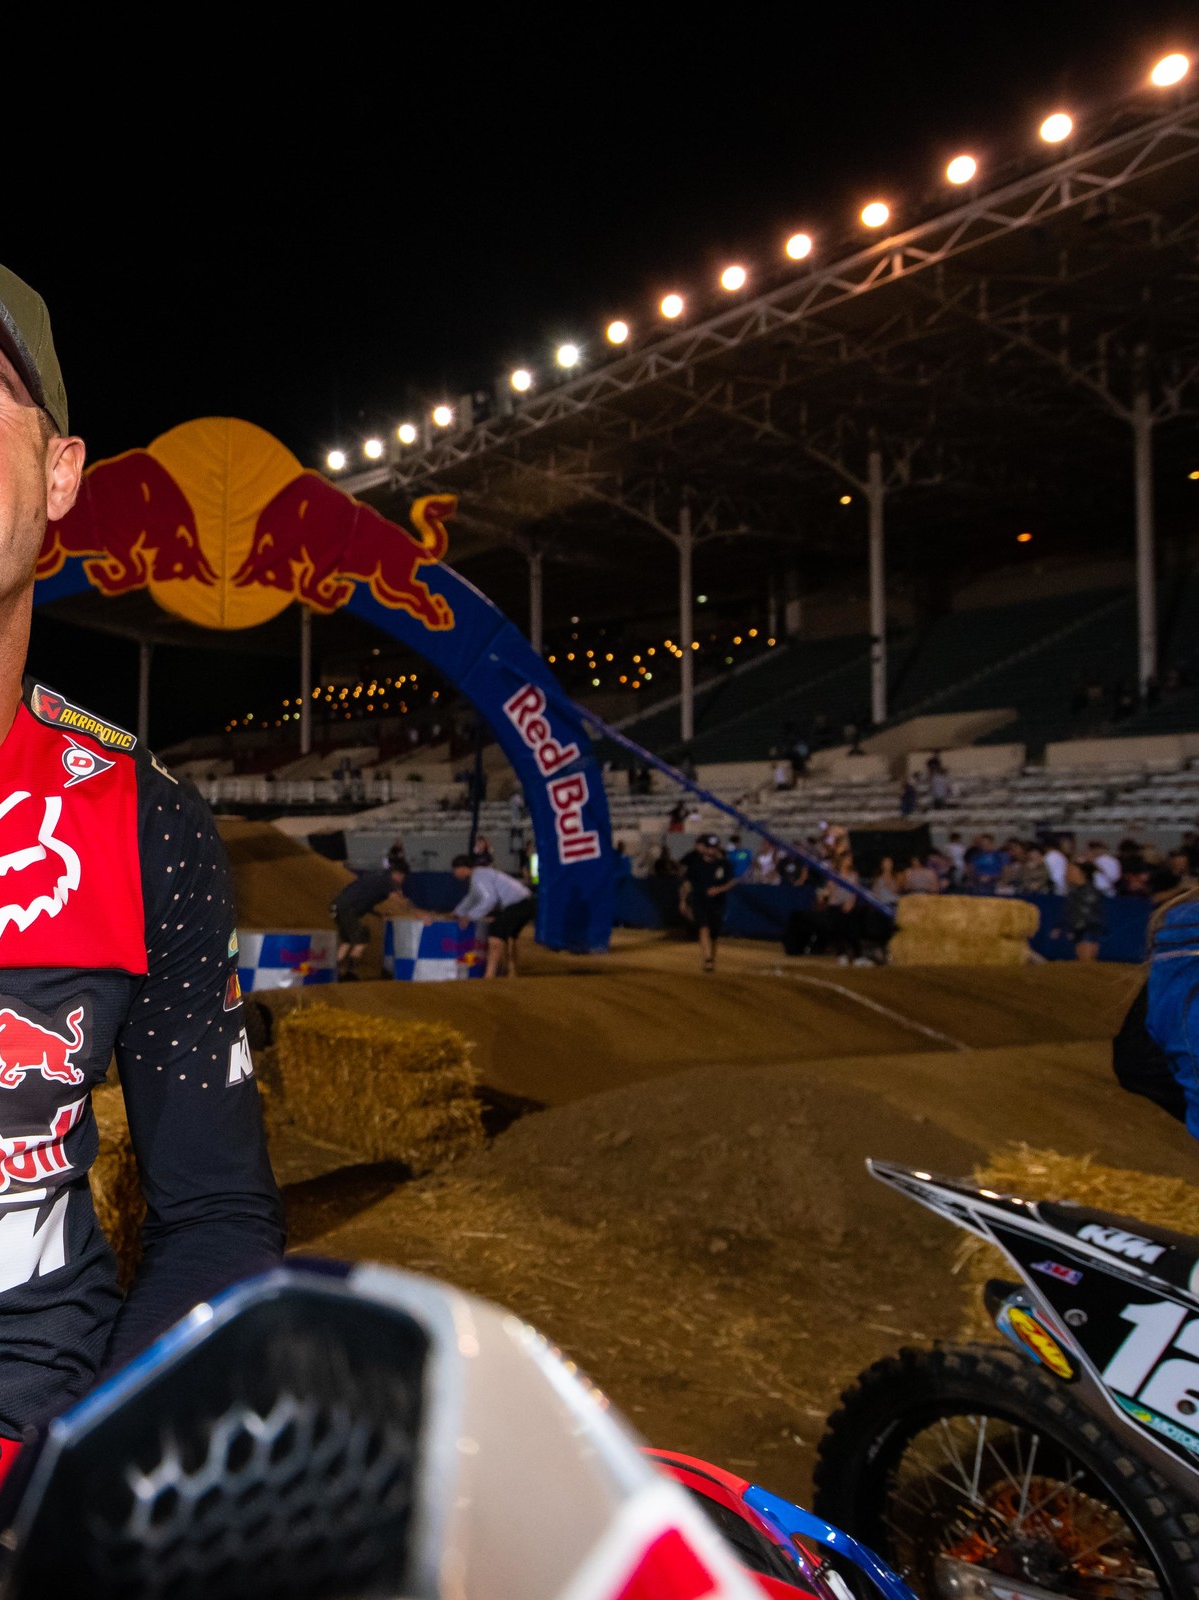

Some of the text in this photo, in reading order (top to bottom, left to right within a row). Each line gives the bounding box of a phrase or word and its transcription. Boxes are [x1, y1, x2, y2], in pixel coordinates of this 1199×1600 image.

[502, 682, 601, 865] Red Bull
[1076, 1223, 1167, 1265] KTM
